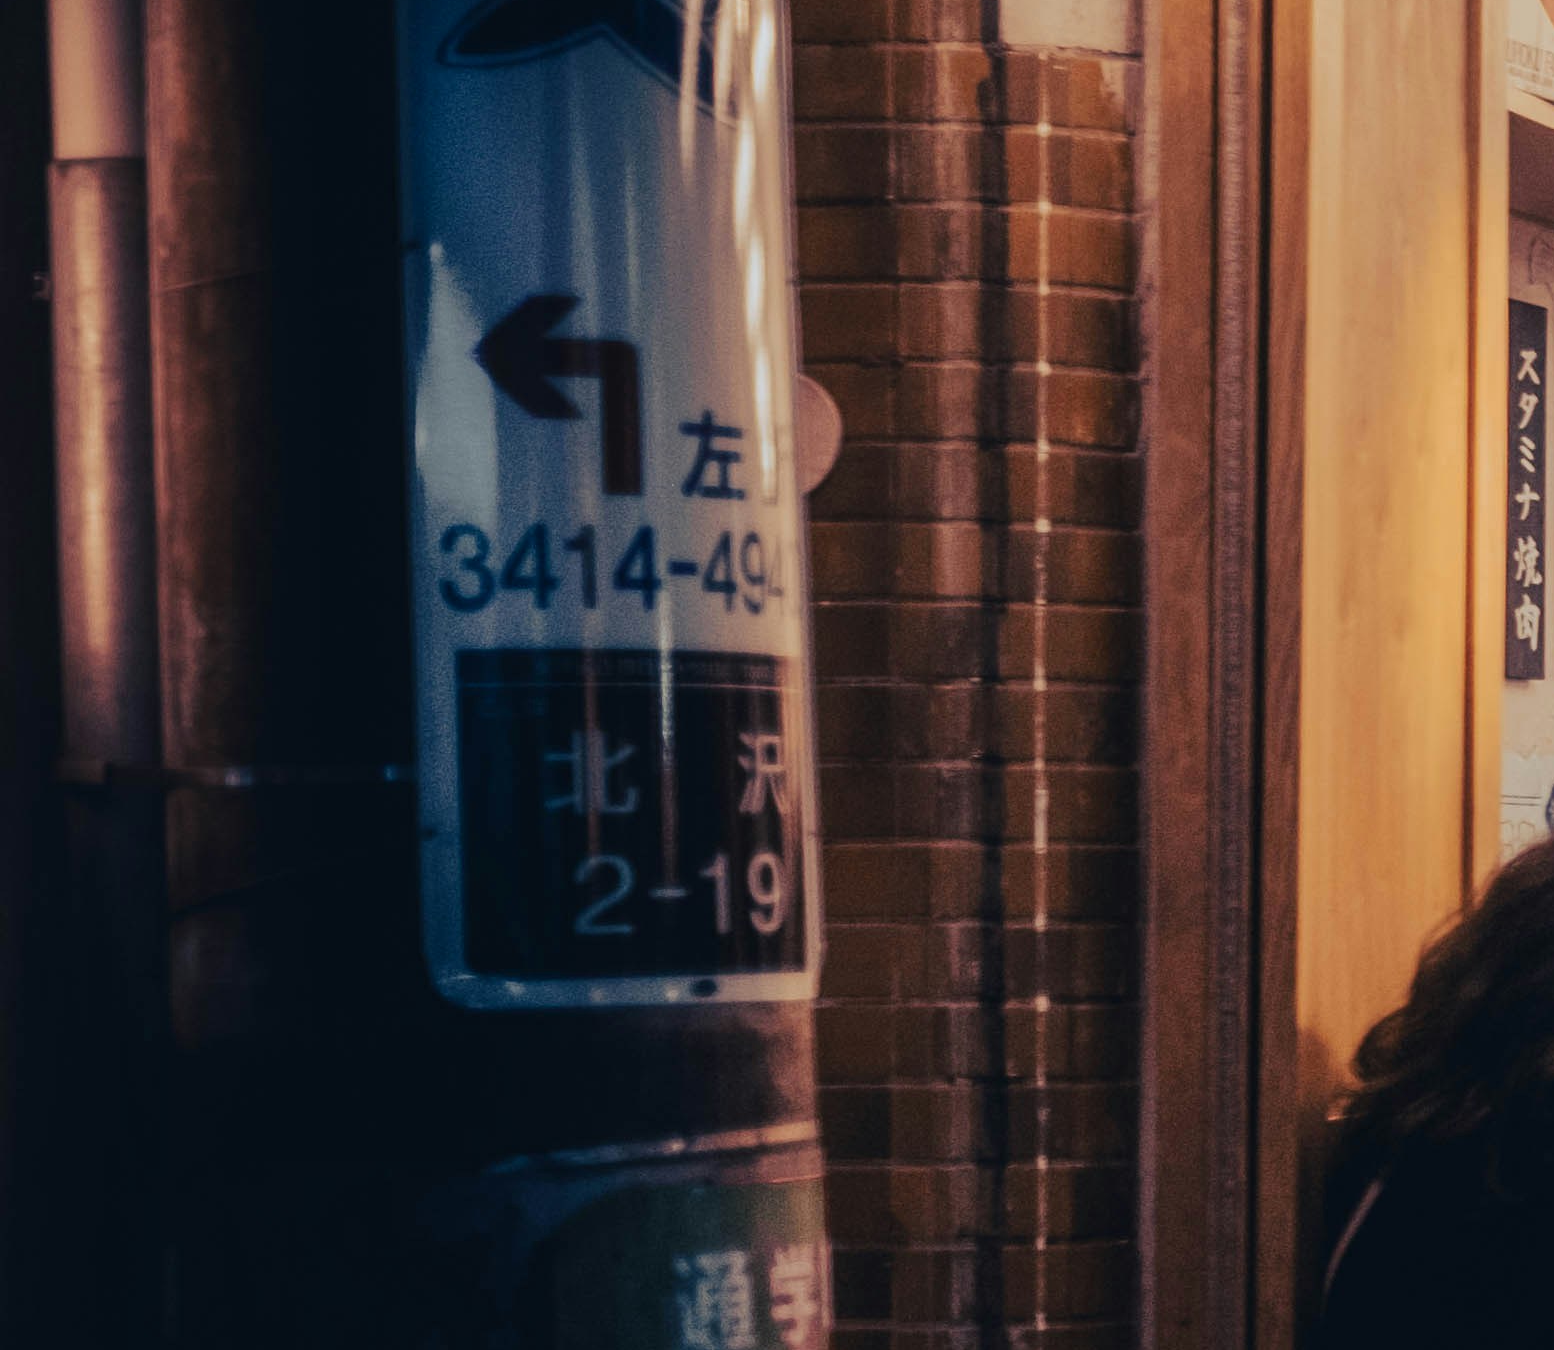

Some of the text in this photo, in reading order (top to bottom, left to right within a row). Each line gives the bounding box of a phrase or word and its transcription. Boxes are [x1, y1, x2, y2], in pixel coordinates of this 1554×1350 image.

[678, 410, 745, 499] 左
[1514, 350, 1542, 651] スタミナ焼肉
